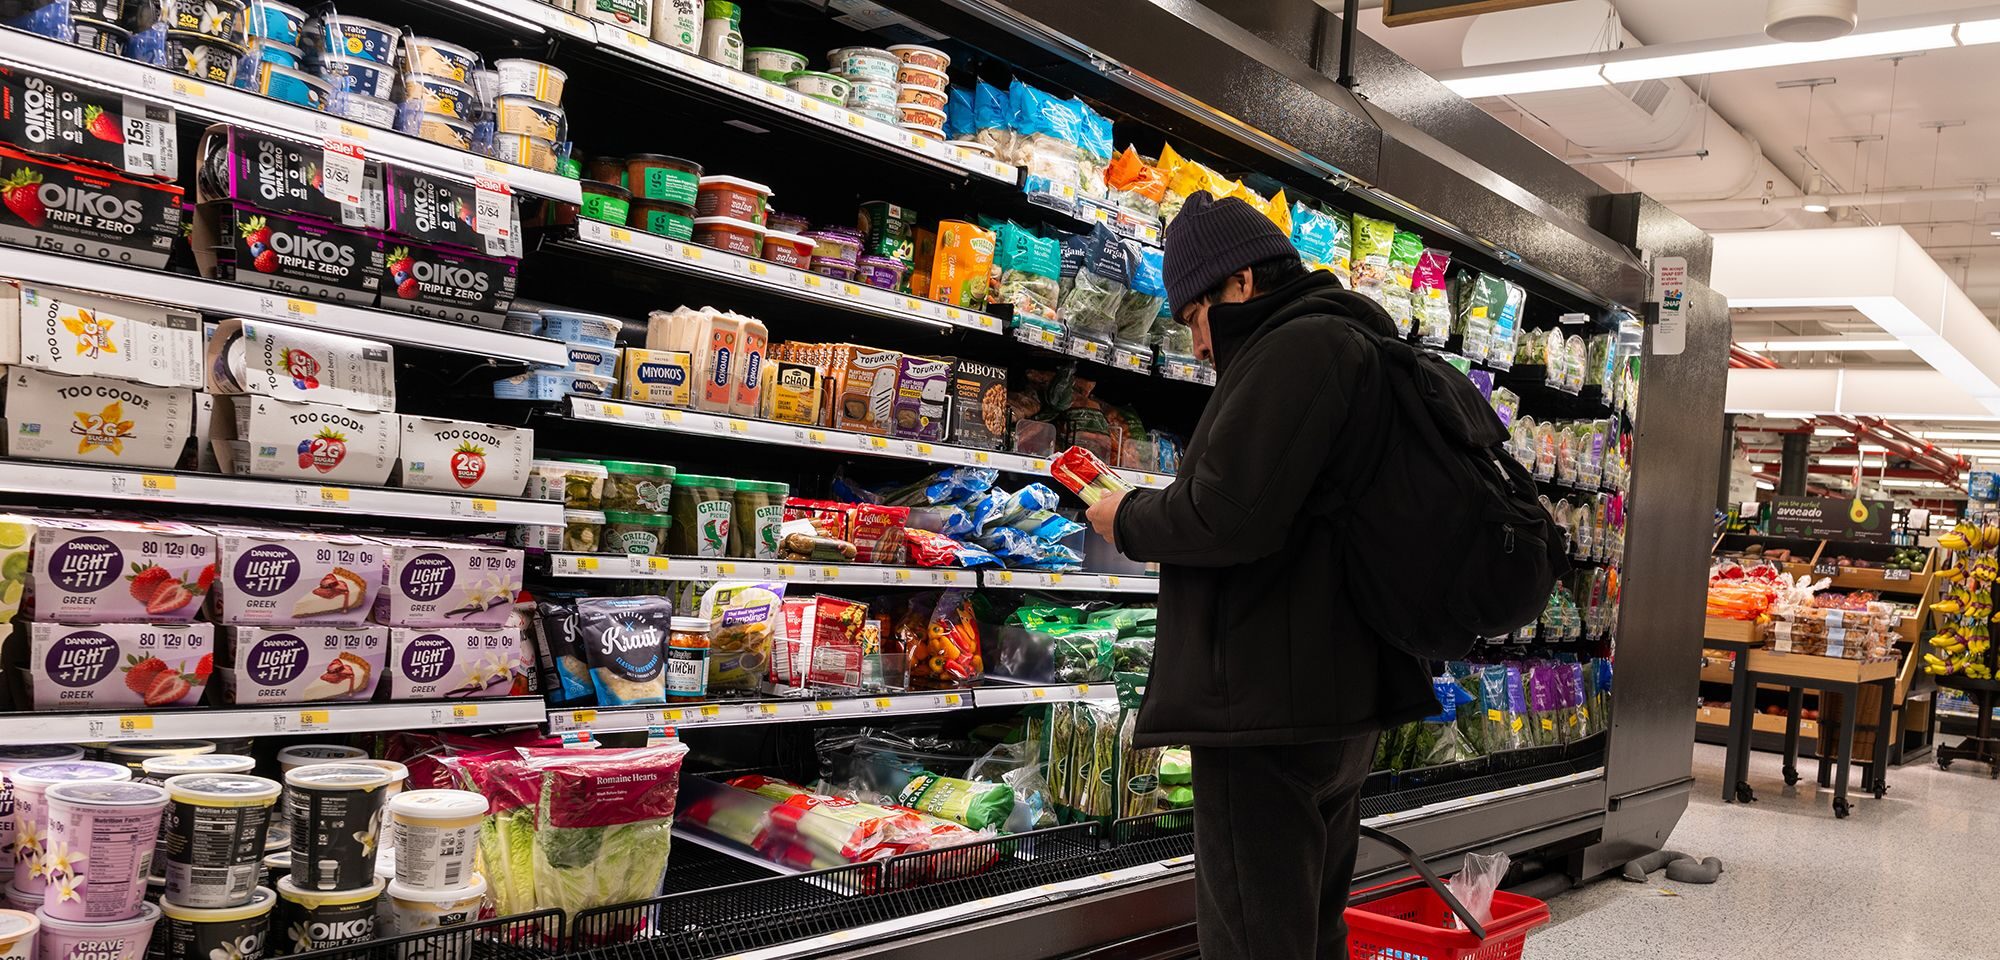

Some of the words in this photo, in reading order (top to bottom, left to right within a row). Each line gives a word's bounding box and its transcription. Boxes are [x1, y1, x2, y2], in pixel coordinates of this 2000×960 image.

[180, 13, 198, 24] 20g
[206, 55, 231, 68] PRO
[210, 67, 226, 77] 20g
[44, 85, 55, 109] ZERO
[24, 77, 46, 143] OIKOS
[45, 109, 56, 140] TRIPLE
[128, 119, 144, 147] 15g
[324, 139, 354, 155] Sale!
[275, 147, 284, 169] ZERO
[259, 141, 276, 200] OIKOS
[324, 167, 350, 184] 3/$4
[475, 177, 502, 193] Sale!
[37, 183, 143, 223] OIKOS
[414, 177, 430, 232] OIKOS
[731, 200, 752, 212] salsa
[477, 205, 500, 219] 3/$4
[45, 208, 93, 227] TRIPLE
[96, 218, 135, 235] ZERO
[35, 235, 64, 251] 15g
[270, 232, 356, 267] OIKOS
[276, 254, 315, 271] TRIPLE
[318, 262, 349, 277] ZERO
[776, 254, 798, 265] salsa
[412, 261, 489, 292] OIKOS
[418, 281, 453, 297] TRIPLE
[454, 288, 483, 301] ZERO
[1663, 300, 1680, 308] SNAP
[80, 323, 98, 347] 2G
[48, 337, 62, 362] TOO
[291, 355, 307, 378] 2G
[861, 354, 896, 364] TOFURKY
[642, 365, 682, 380] MIYOKO'S
[911, 364, 944, 374] TOFURKY
[957, 362, 1007, 380] ABBOT'S
[266, 369, 279, 391] TOO
[784, 375, 808, 386] CHAO
[57, 386, 92, 400] TOO
[86, 415, 118, 436] 2G
[290, 413, 318, 425] TOO
[87, 434, 113, 443] SUGAR
[434, 429, 460, 442] TOO
[312, 438, 340, 458] 2G
[456, 453, 479, 471] 2G
[1777, 507, 1822, 518] avocado
[624, 532, 656, 543] GRILLO'S
[68, 542, 106, 551] DANNON
[142, 541, 158, 553] 80
[164, 542, 184, 555] 12g
[190, 543, 205, 556] 0g
[251, 549, 286, 558] DANNON
[61, 552, 114, 573] LIGHT
[316, 549, 331, 560] 80
[337, 550, 355, 562] 12g
[360, 551, 373, 563] 0g
[469, 557, 481, 567] 80
[486, 557, 501, 568] 12g
[505, 557, 516, 569] 0g
[245, 559, 291, 578] LIGHT
[410, 566, 447, 585] LIGHT
[74, 570, 107, 587] FIT
[257, 576, 286, 592] FIT
[420, 582, 443, 597] FIT
[62, 596, 97, 605] GREEK
[246, 600, 277, 608] GREEK
[410, 604, 436, 612] GREEK
[725, 613, 766, 625] Dumplings
[65, 638, 104, 646] DANNON
[140, 633, 156, 645] 80
[162, 633, 181, 646] 12g
[187, 634, 202, 647] 0g
[324, 635, 339, 646] 80
[343, 635, 360, 647] 12g
[365, 635, 378, 647] 0g
[467, 636, 479, 647] 80
[484, 636, 498, 647] 12g
[502, 636, 513, 648] 0g
[601, 625, 661, 655] Kraut
[58, 646, 109, 668] LIGHT
[257, 648, 300, 668] LIGHT
[411, 648, 447, 665] LIGHT
[71, 664, 103, 682] FIT
[269, 664, 295, 681] FIT
[421, 663, 443, 678] FIT
[667, 663, 696, 674] KIMCHI
[60, 691, 94, 699] GREEK
[258, 689, 287, 697] GREEK
[597, 775, 631, 784] Romaine
[632, 772, 658, 782] Hearts
[906, 778, 934, 808] RGANIC
[309, 916, 374, 939] OIKOS
[78, 940, 124, 951] CRAVE
[70, 951, 120, 960] MORE
